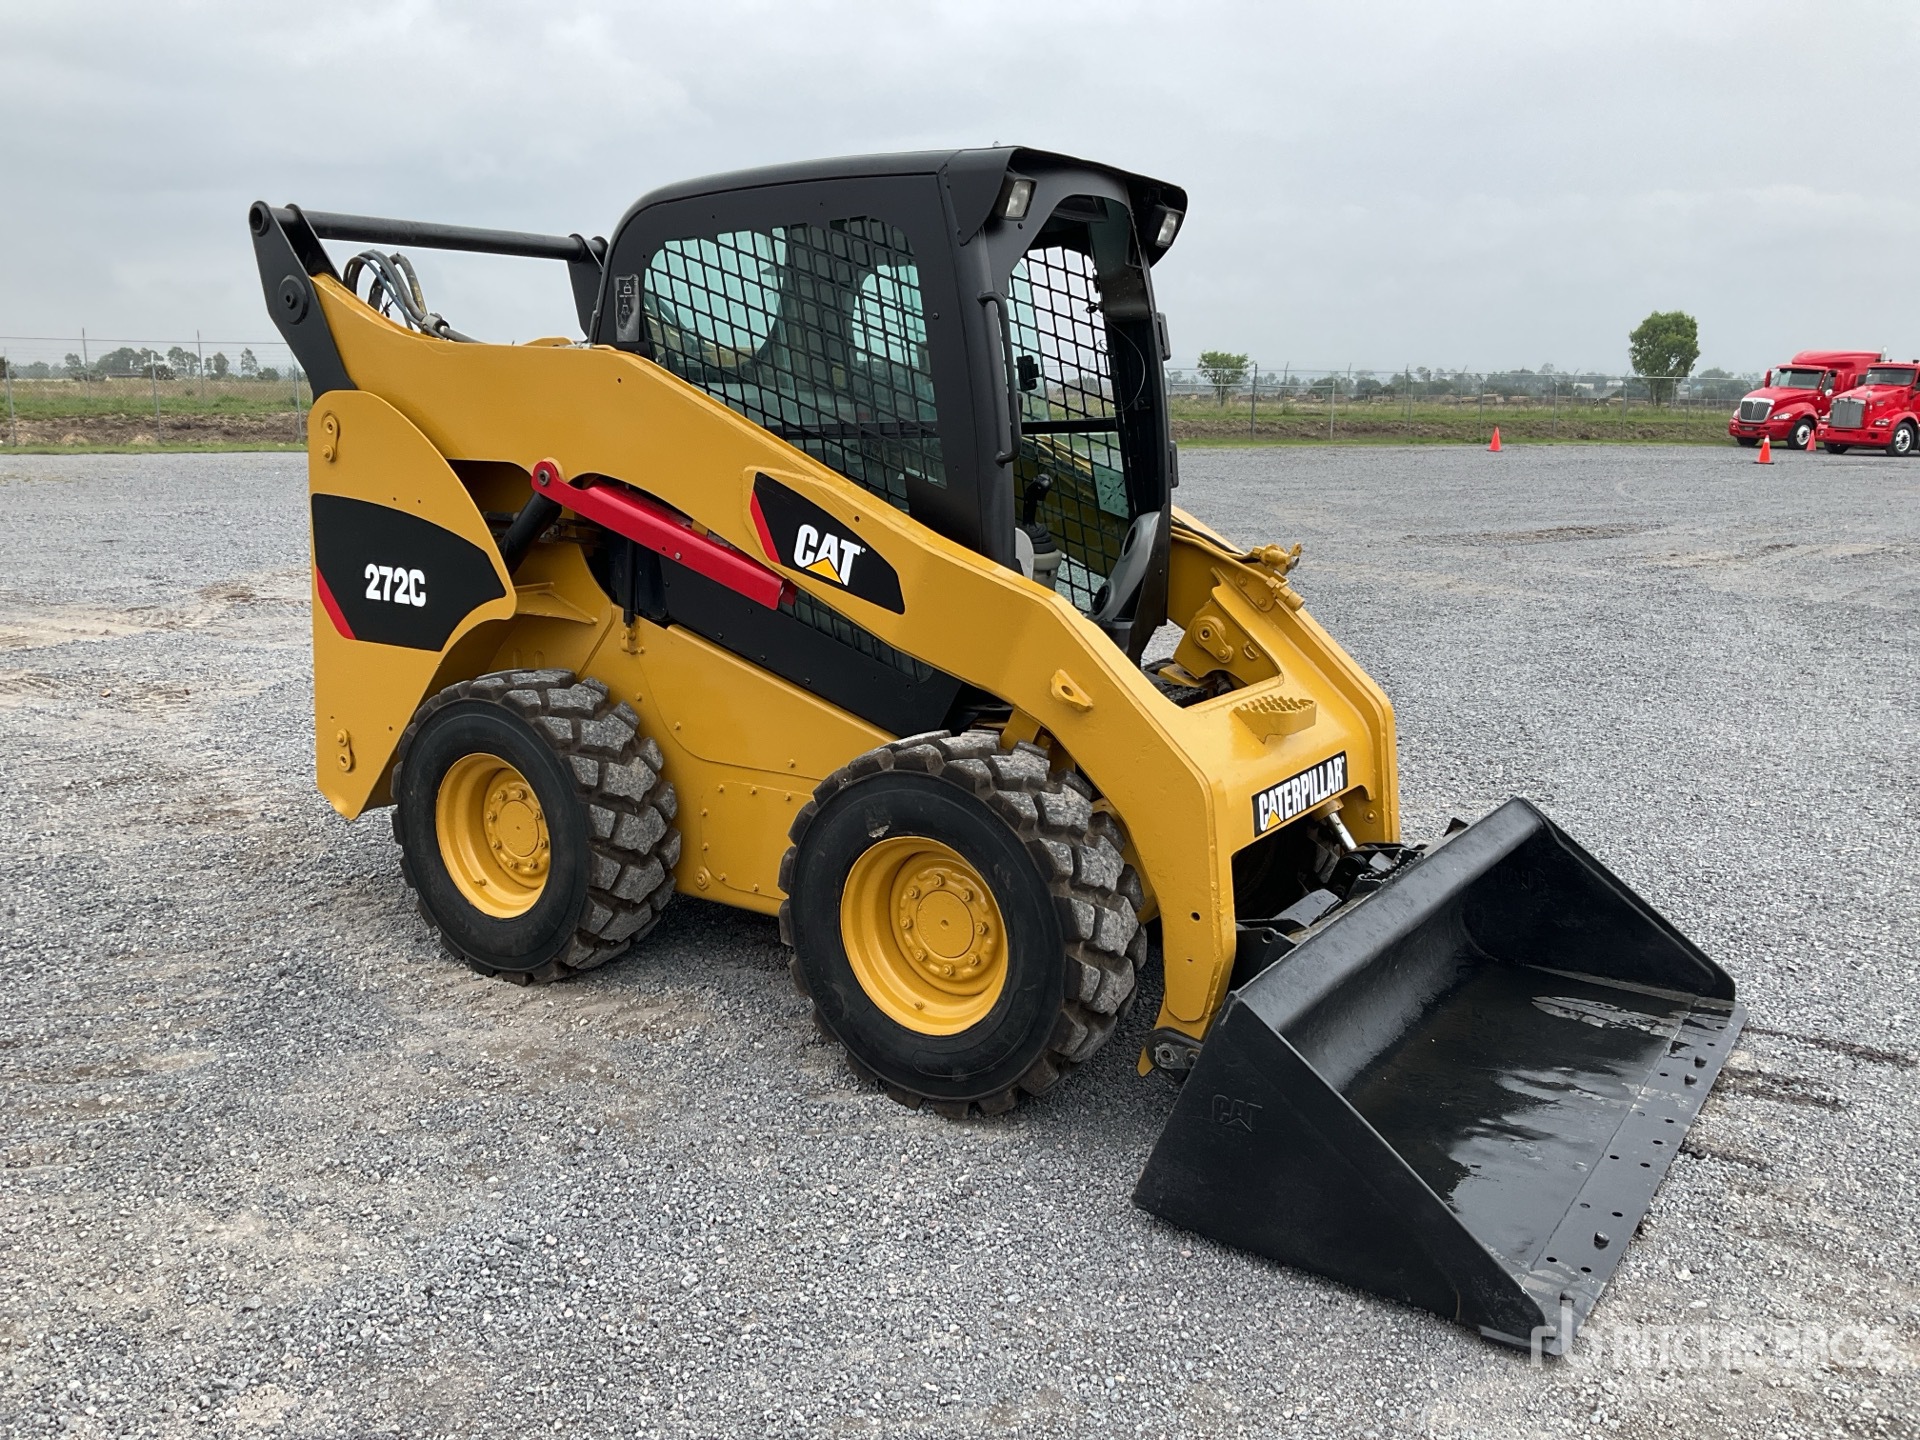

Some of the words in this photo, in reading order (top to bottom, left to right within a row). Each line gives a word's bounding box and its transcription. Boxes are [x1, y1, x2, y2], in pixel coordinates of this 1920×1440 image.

[794, 524, 863, 586] CAT
[364, 563, 427, 607] 272C
[1258, 755, 1344, 831] CATERPILLAR
[1211, 1094, 1263, 1132] CAT
